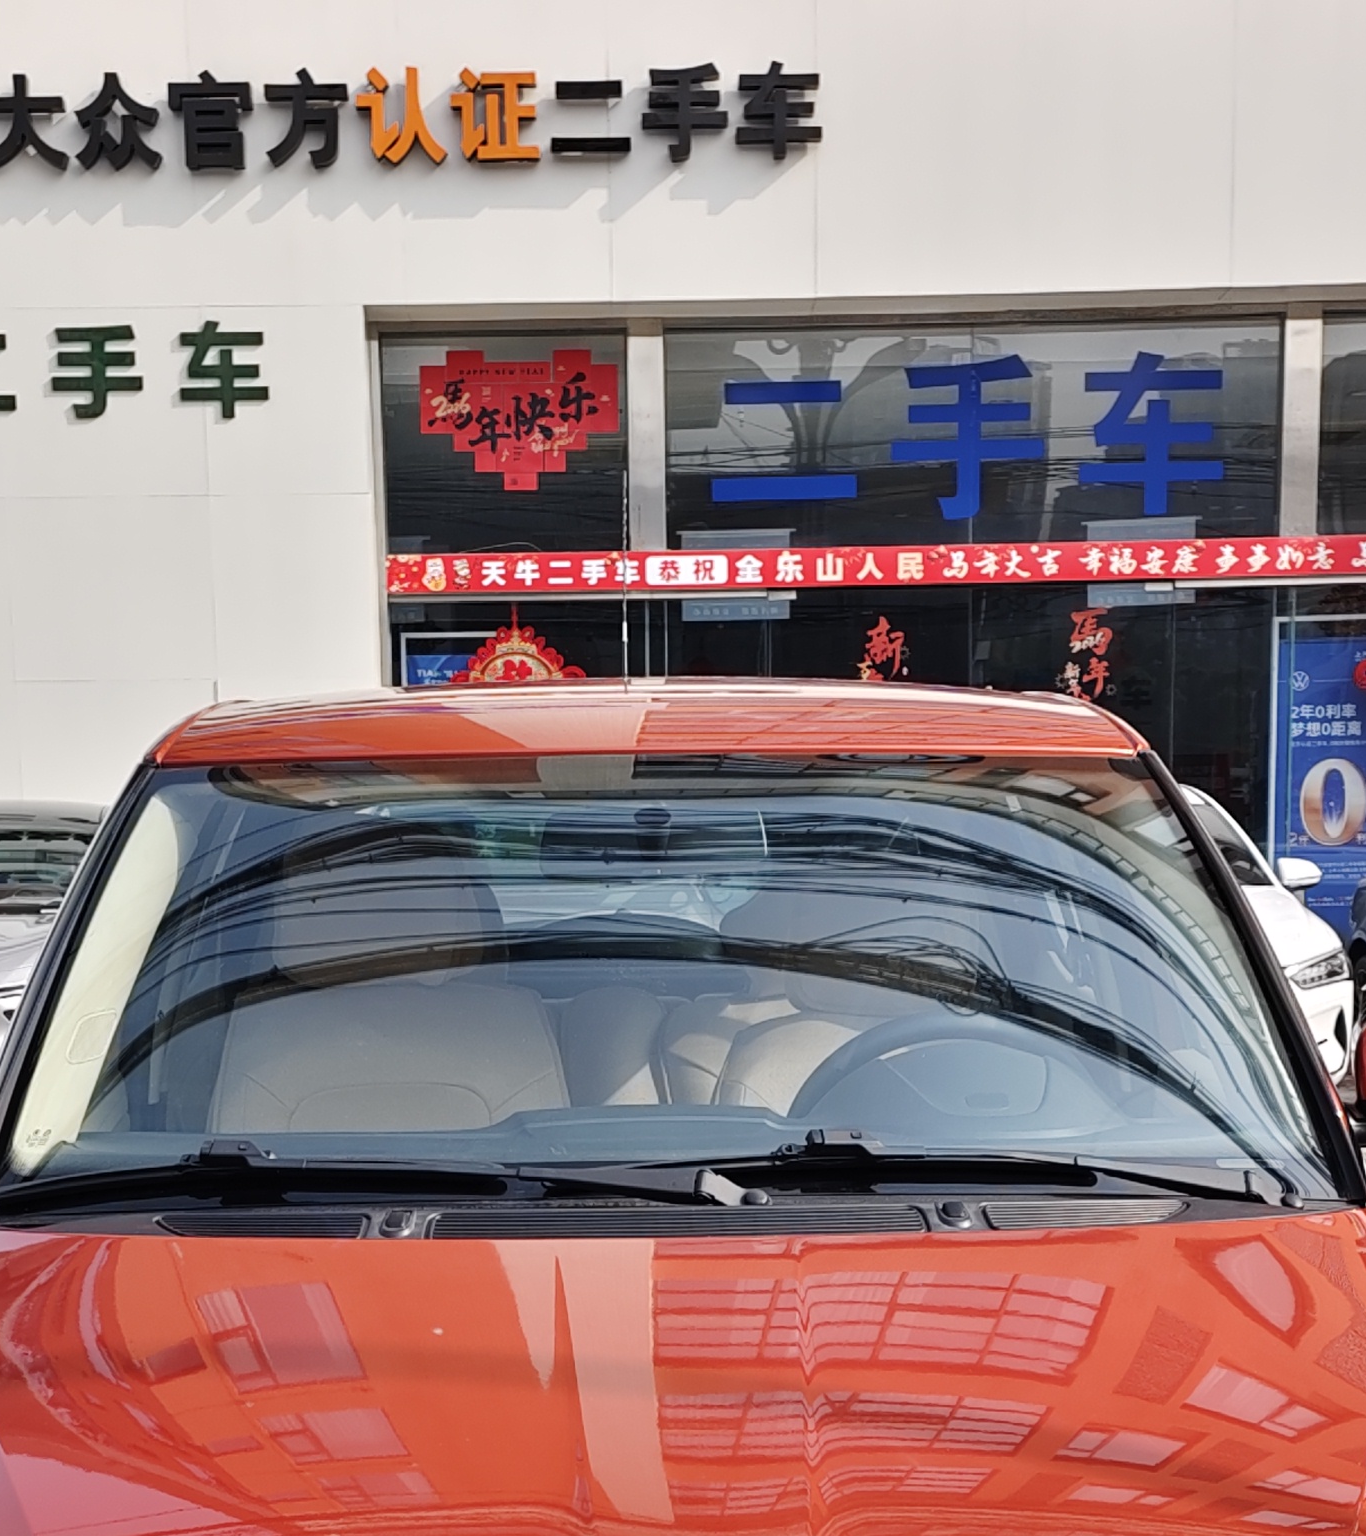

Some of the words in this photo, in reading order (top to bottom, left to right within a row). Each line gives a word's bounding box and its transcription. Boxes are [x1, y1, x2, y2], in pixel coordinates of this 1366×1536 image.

[711, 351, 1225, 521] 二手车
[481, 559, 641, 586] 天牛二手车
[658, 559, 716, 582] 恭祝
[1078, 545, 1200, 577] 幸福安康
[1291, 703, 1357, 719] 2年0利率
[1290, 720, 1363, 737] 梦想0距离
